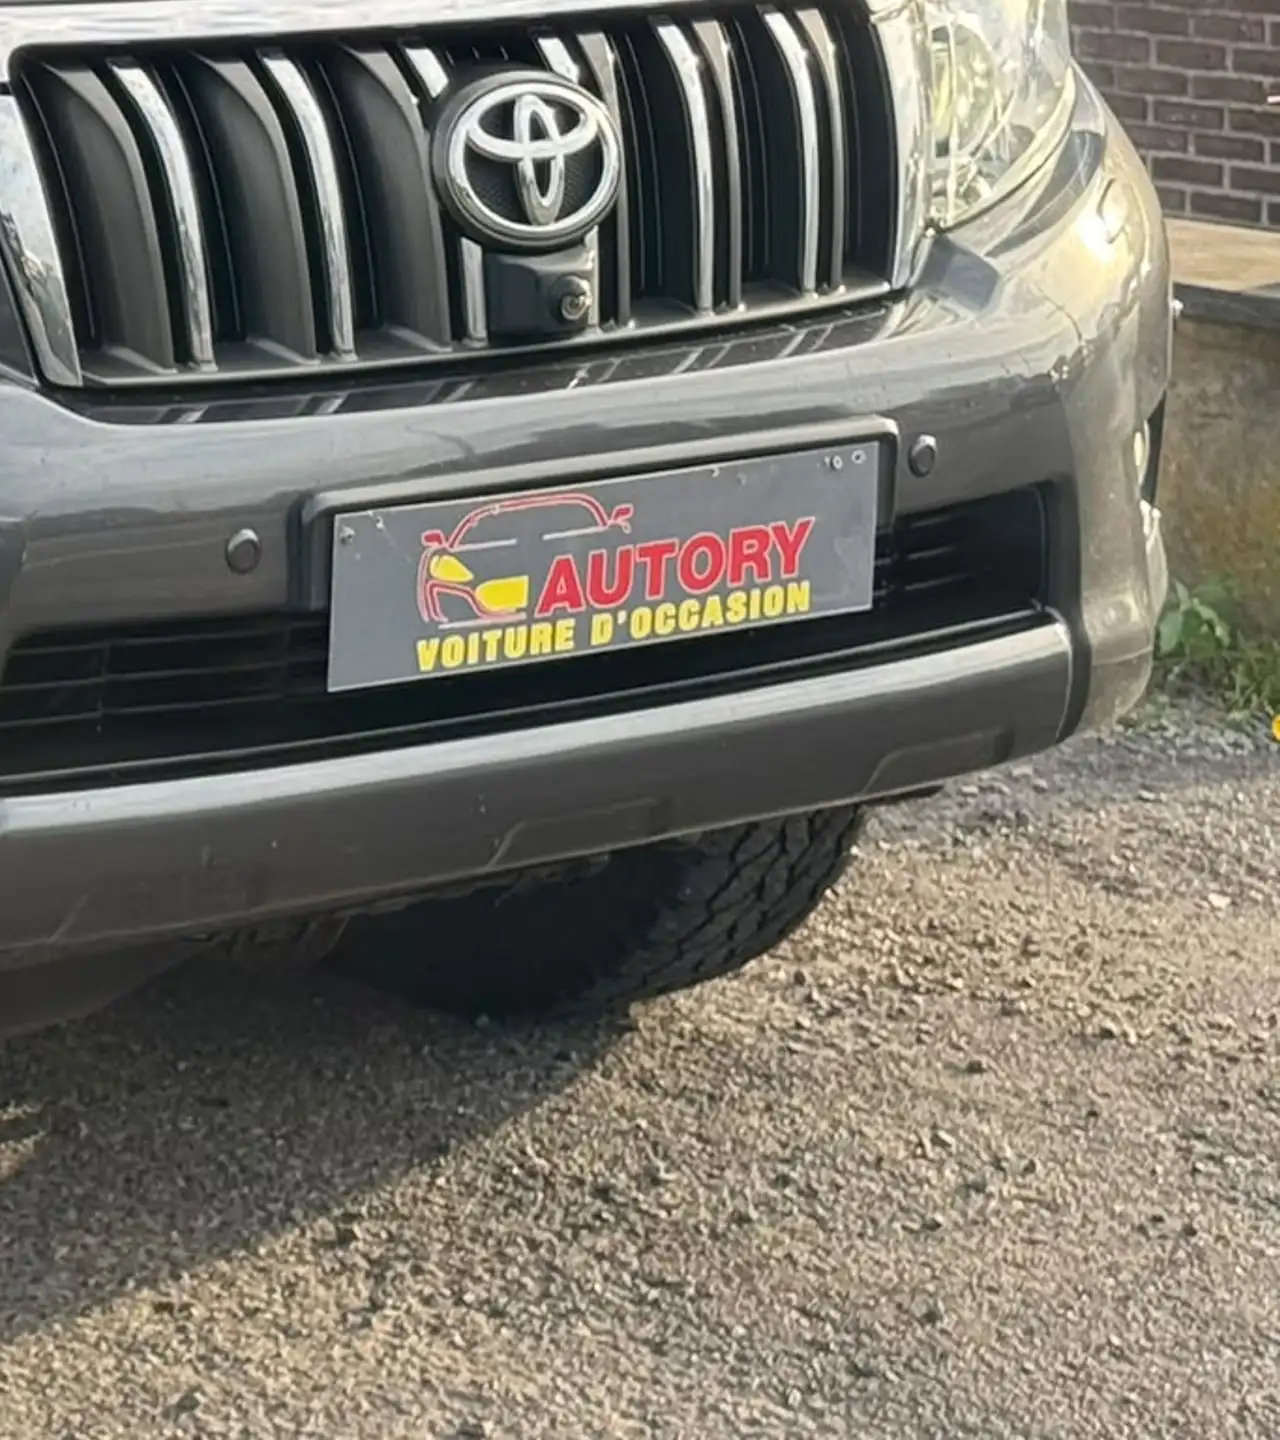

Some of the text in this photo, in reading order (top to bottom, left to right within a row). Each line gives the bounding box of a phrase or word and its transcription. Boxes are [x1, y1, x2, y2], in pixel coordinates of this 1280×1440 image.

[535, 517, 817, 618] AUTORY
[416, 581, 811, 672] VOITURE D'OCCASION
